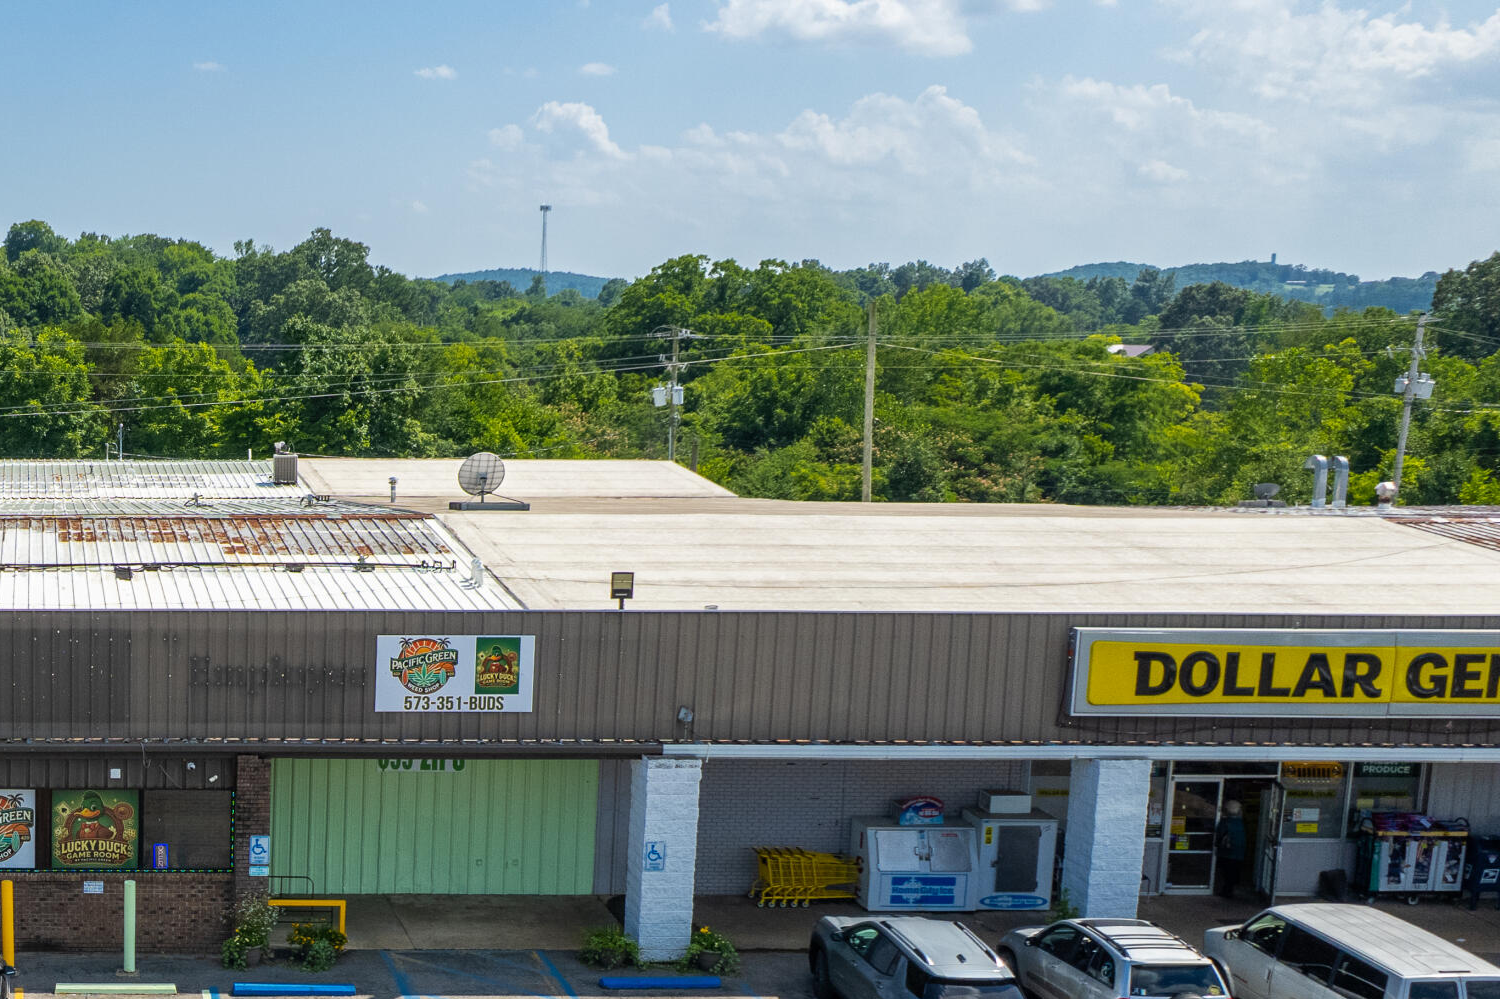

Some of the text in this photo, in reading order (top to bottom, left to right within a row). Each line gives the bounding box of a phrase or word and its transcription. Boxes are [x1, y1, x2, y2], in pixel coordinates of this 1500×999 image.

[391, 651, 457, 670] PACIFIC GREEN
[479, 672, 498, 681] LUCKY
[1134, 650, 1383, 698] DOLLAR
[407, 682, 441, 693] WEED SHOP
[403, 696, 505, 711] 573-351-BUDS
[1362, 765, 1411, 774] PRODUCE
[61, 840, 128, 854] LUCKY DUCK
[66, 851, 120, 860] GAME ROOM
